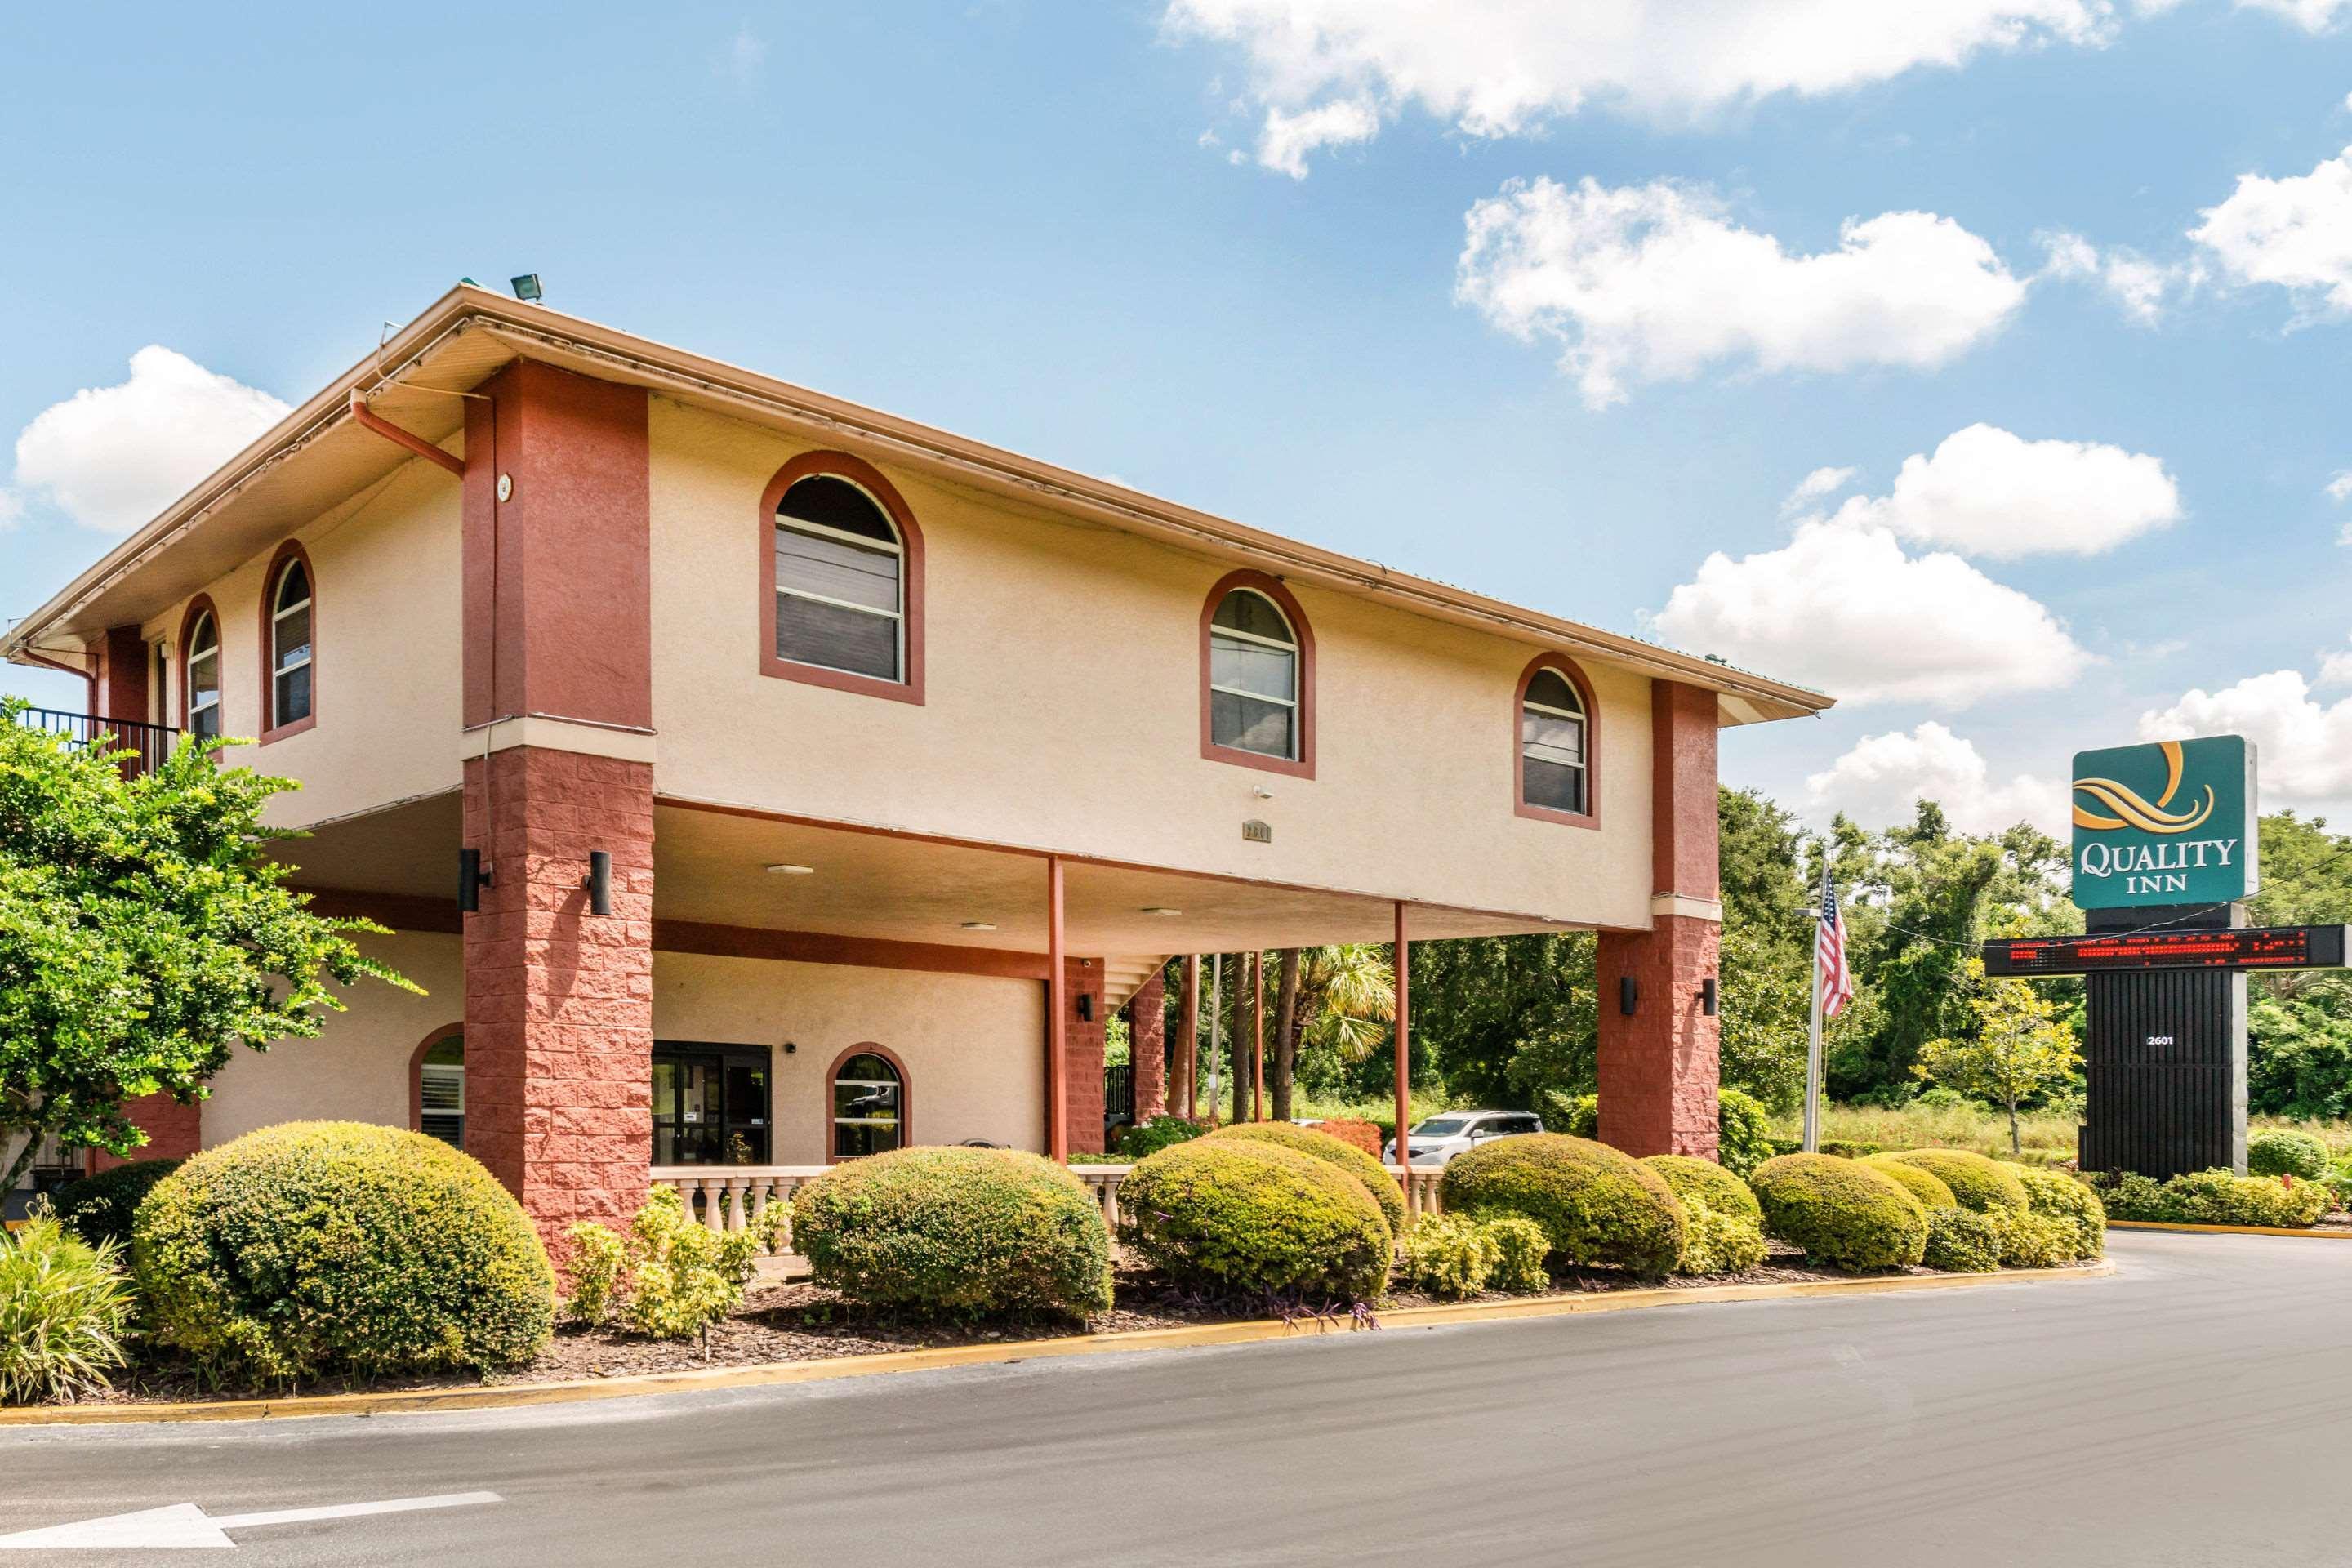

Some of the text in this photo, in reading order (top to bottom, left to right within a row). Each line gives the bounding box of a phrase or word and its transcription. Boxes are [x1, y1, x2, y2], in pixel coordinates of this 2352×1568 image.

[2081, 839, 2238, 878] QUALITY
[2126, 874, 2188, 893] INN
[2147, 1036, 2173, 1045] 2601
